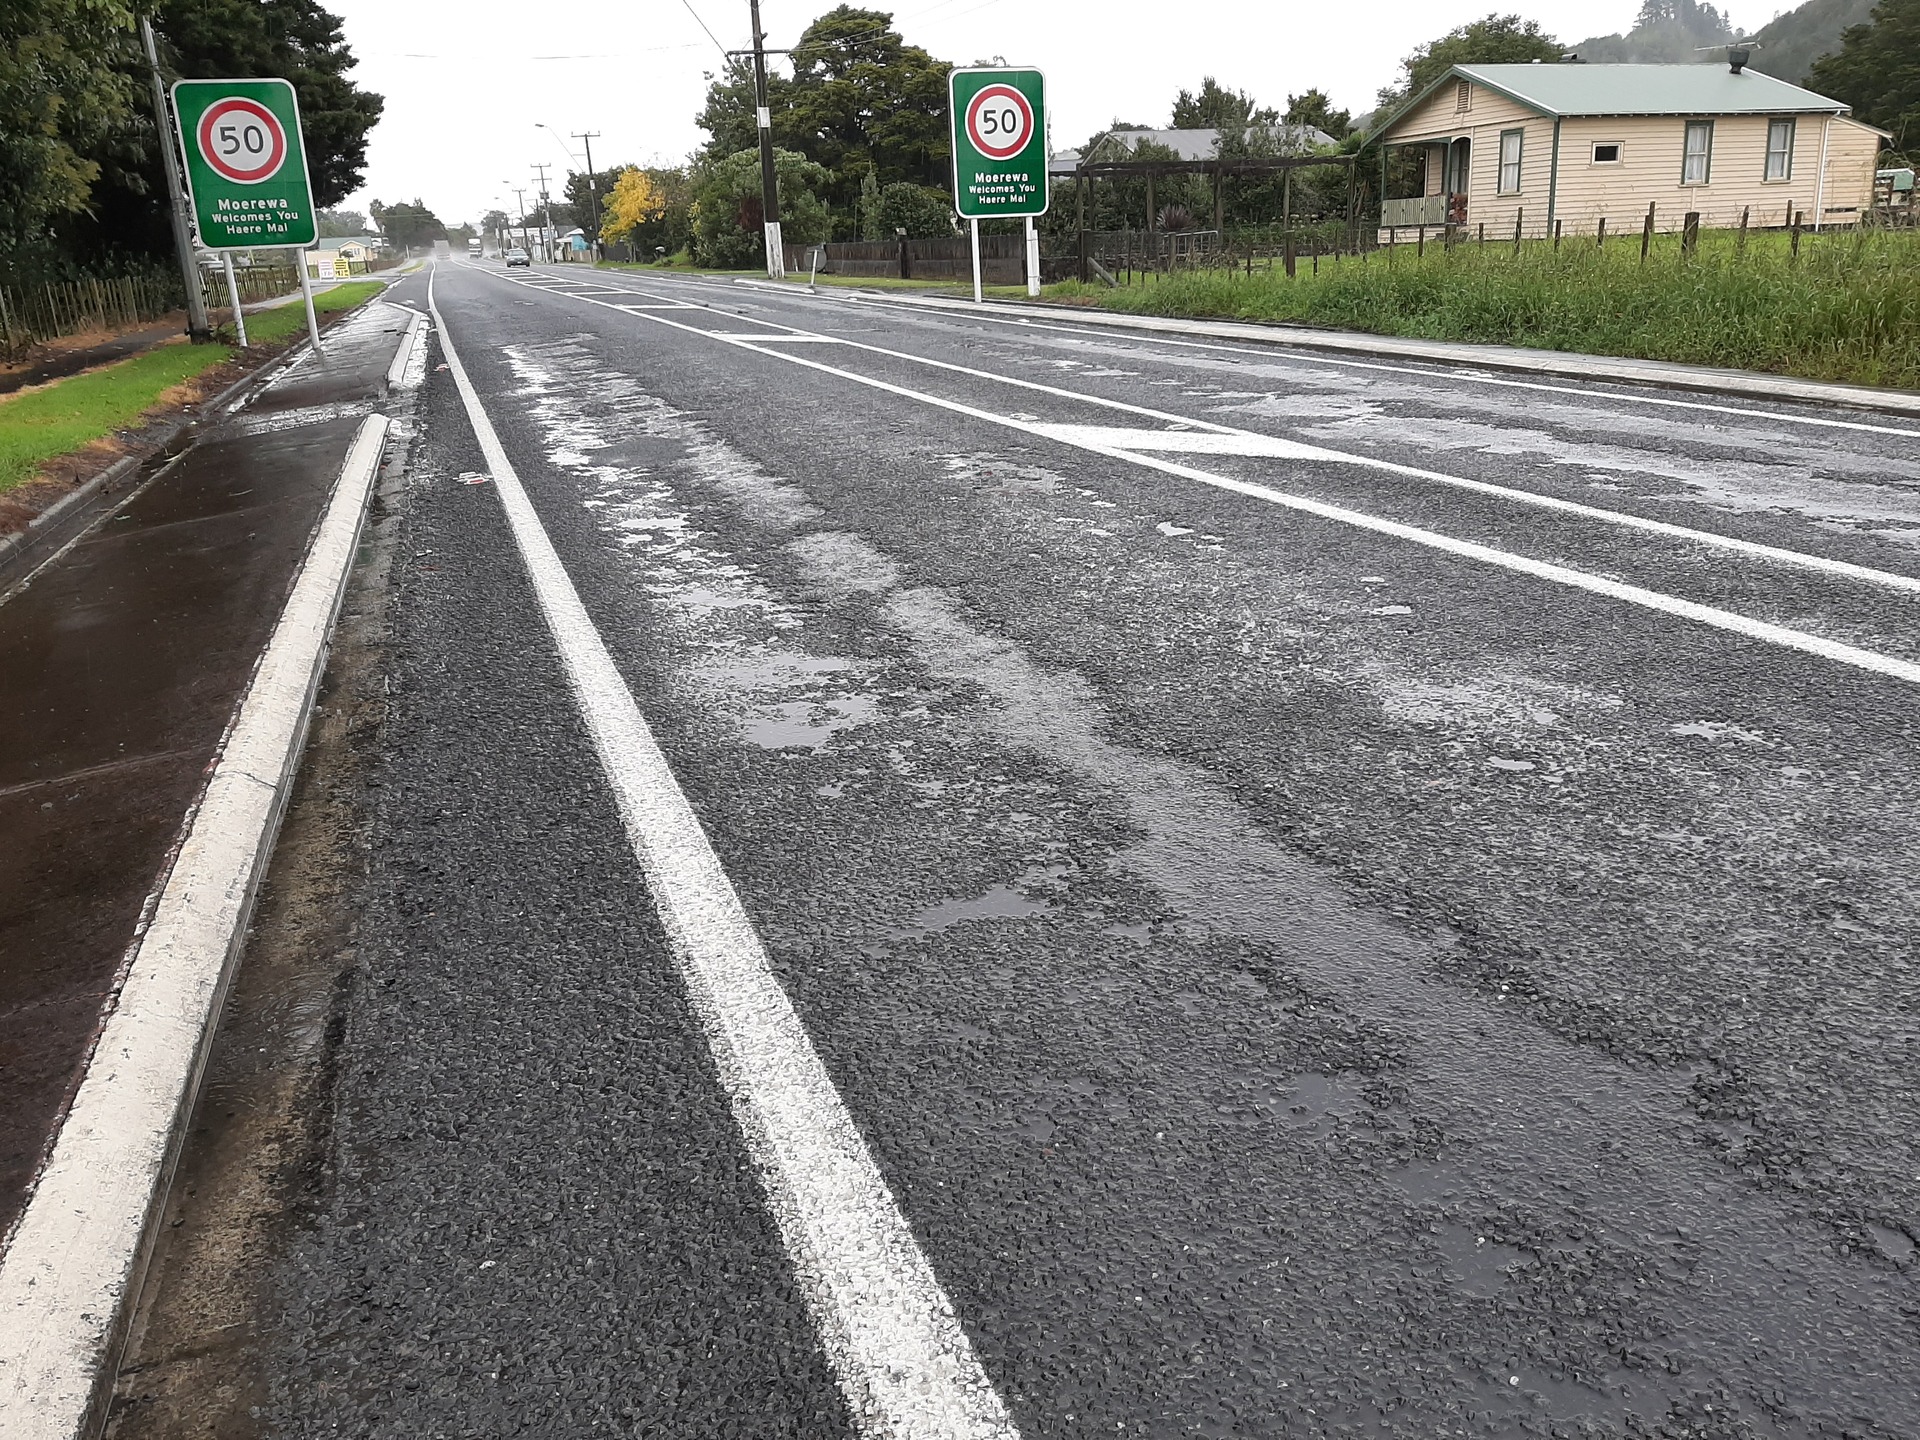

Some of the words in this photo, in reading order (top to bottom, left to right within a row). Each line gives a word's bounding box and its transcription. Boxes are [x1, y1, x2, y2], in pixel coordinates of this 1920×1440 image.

[983, 109, 1017, 135] 50
[219, 124, 264, 155] 50
[975, 172, 1029, 183] Moerewa
[968, 185, 1015, 194] Welcomes
[1019, 184, 1036, 192] You
[217, 198, 288, 211] Moerewa
[978, 195, 1006, 204] Haere
[1010, 194, 1027, 203] Mai
[211, 213, 272, 223] Welcomes
[276, 210, 299, 220] You
[226, 224, 262, 234] Haere
[267, 222, 288, 233] Mai
